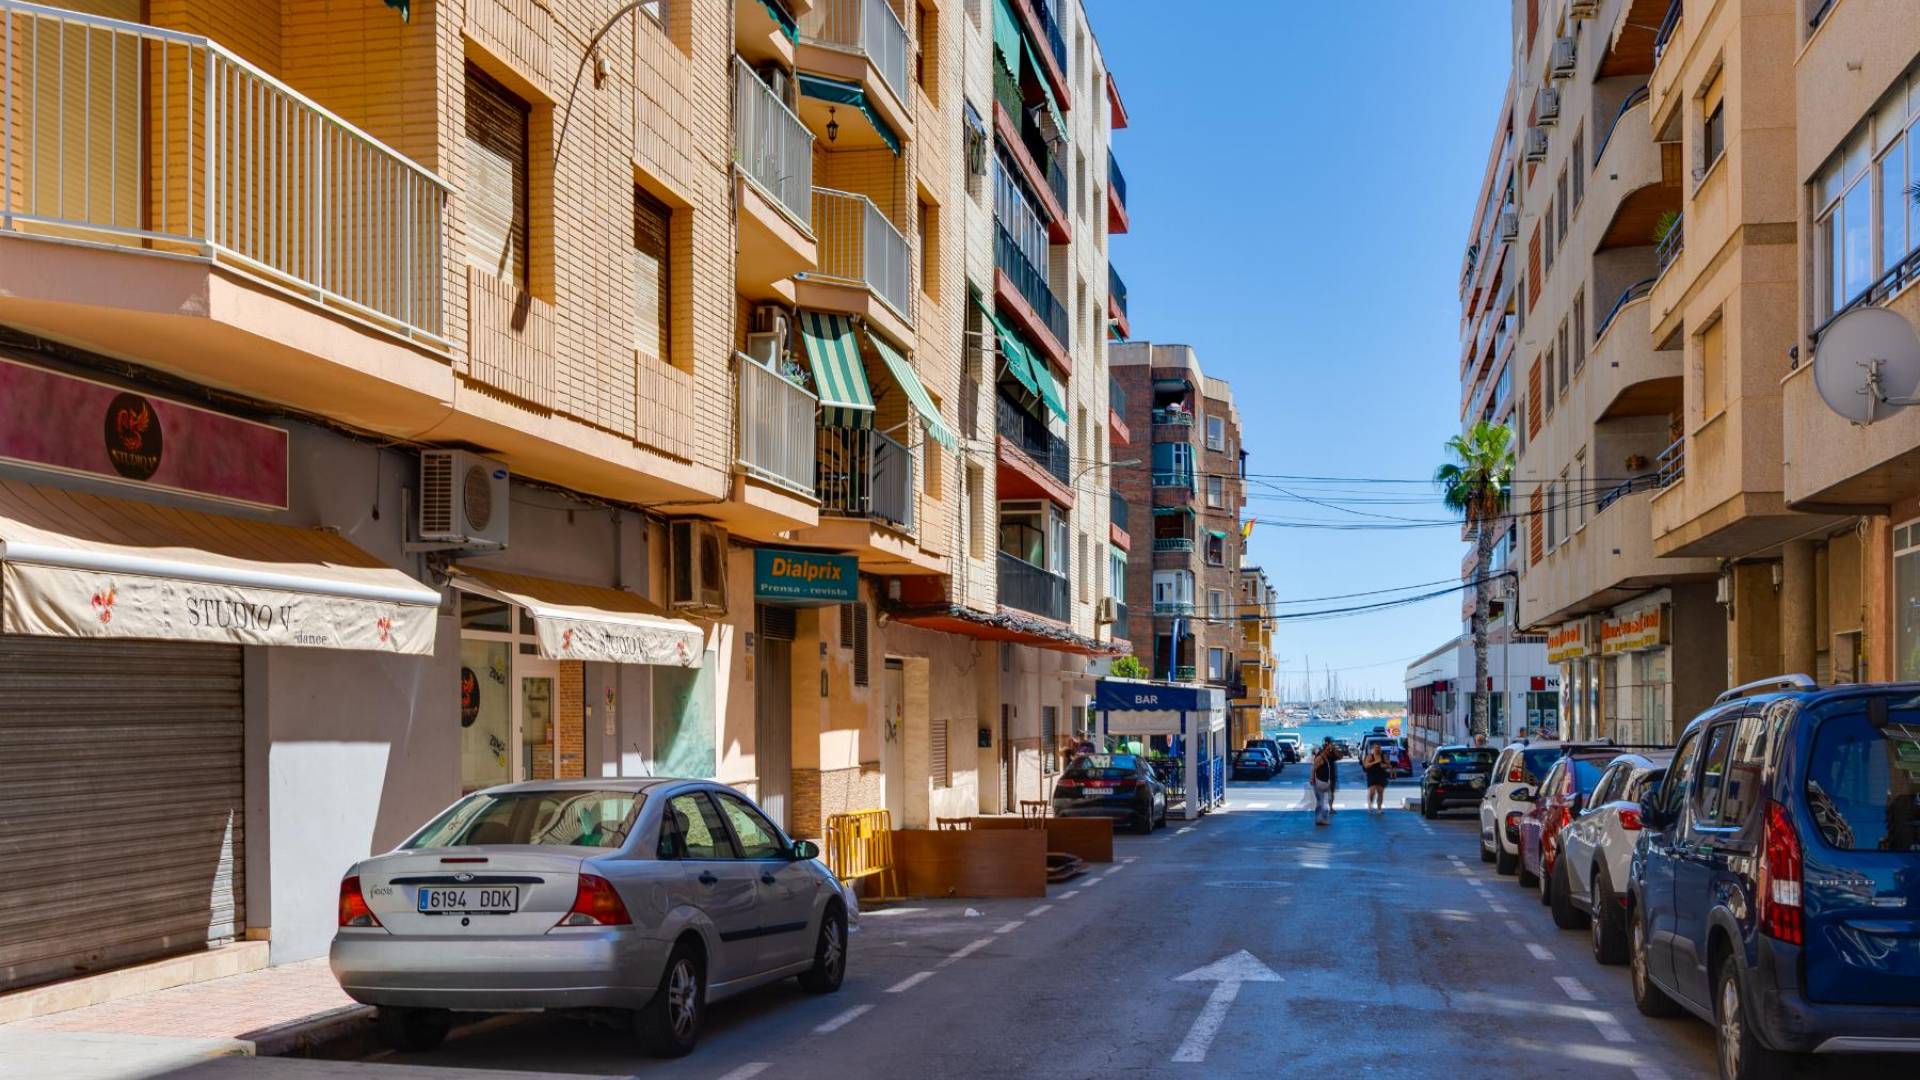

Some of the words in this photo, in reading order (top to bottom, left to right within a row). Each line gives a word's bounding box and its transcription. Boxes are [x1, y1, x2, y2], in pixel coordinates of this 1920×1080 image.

[771, 555, 842, 582] Dialprix
[761, 583, 800, 593] Prensa
[810, 587, 848, 596] revista
[186, 596, 273, 632] STUDIO
[280, 605, 292, 633] V
[297, 630, 328, 645] dance
[1135, 695, 1159, 704] BAR
[431, 891, 467, 908] 6194
[480, 890, 512, 908] DDK
